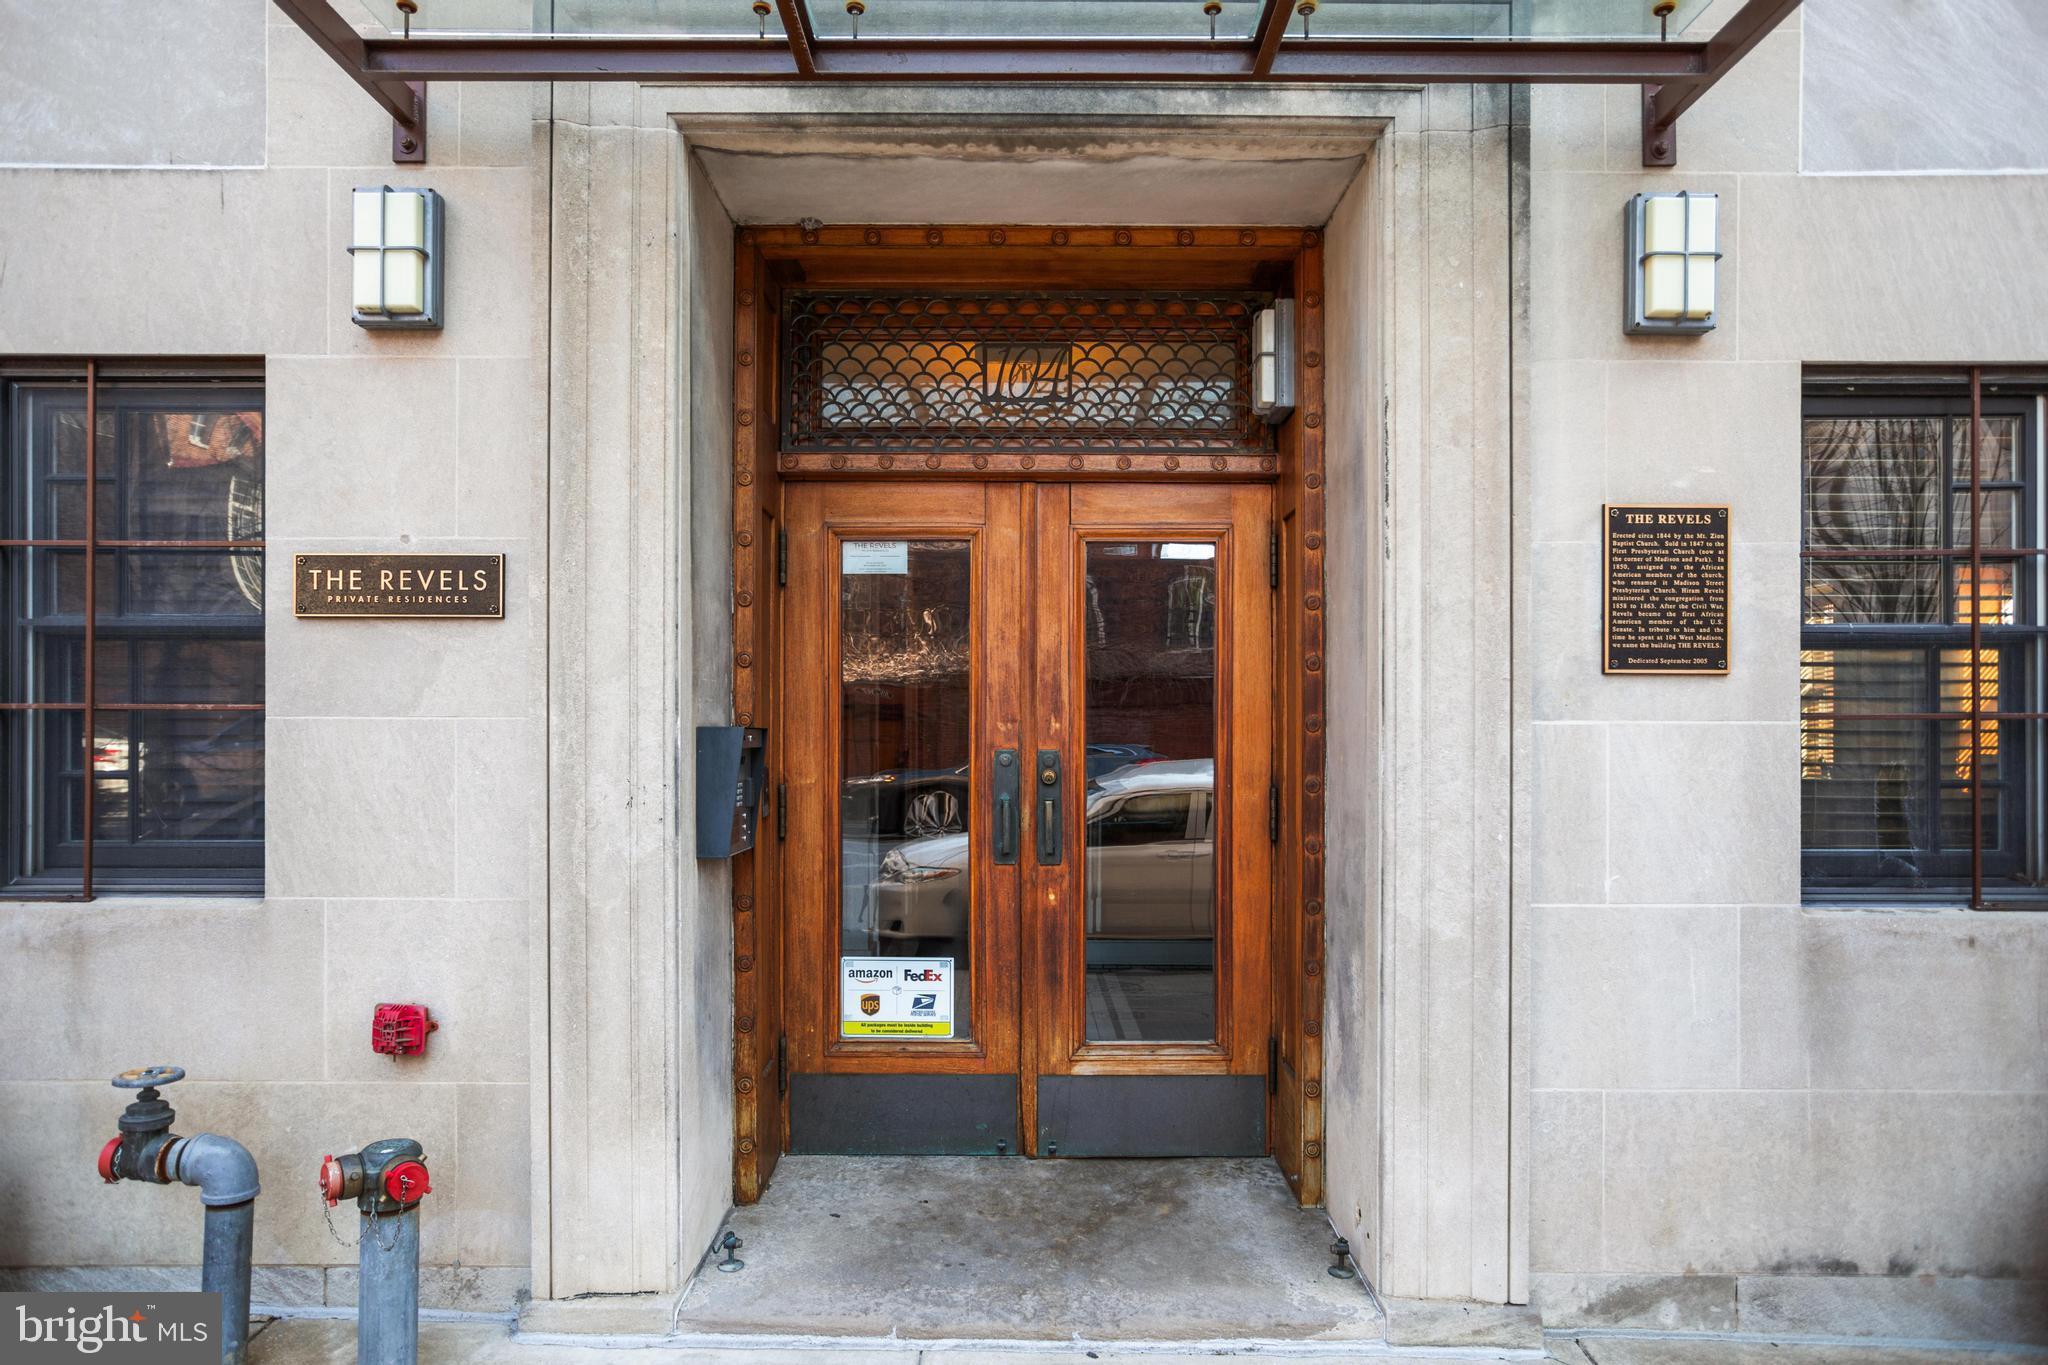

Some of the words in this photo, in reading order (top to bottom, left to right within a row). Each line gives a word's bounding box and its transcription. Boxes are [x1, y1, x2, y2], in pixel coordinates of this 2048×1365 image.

[990, 345, 1071, 401] 104
[1626, 514, 1654, 524] THE
[1658, 514, 1711, 524] REVELS
[309, 570, 362, 590] THE
[380, 569, 487, 591] REVELS
[848, 969, 893, 978] amazon
[904, 969, 942, 981] FedEx
[862, 1001, 879, 1012] ups
